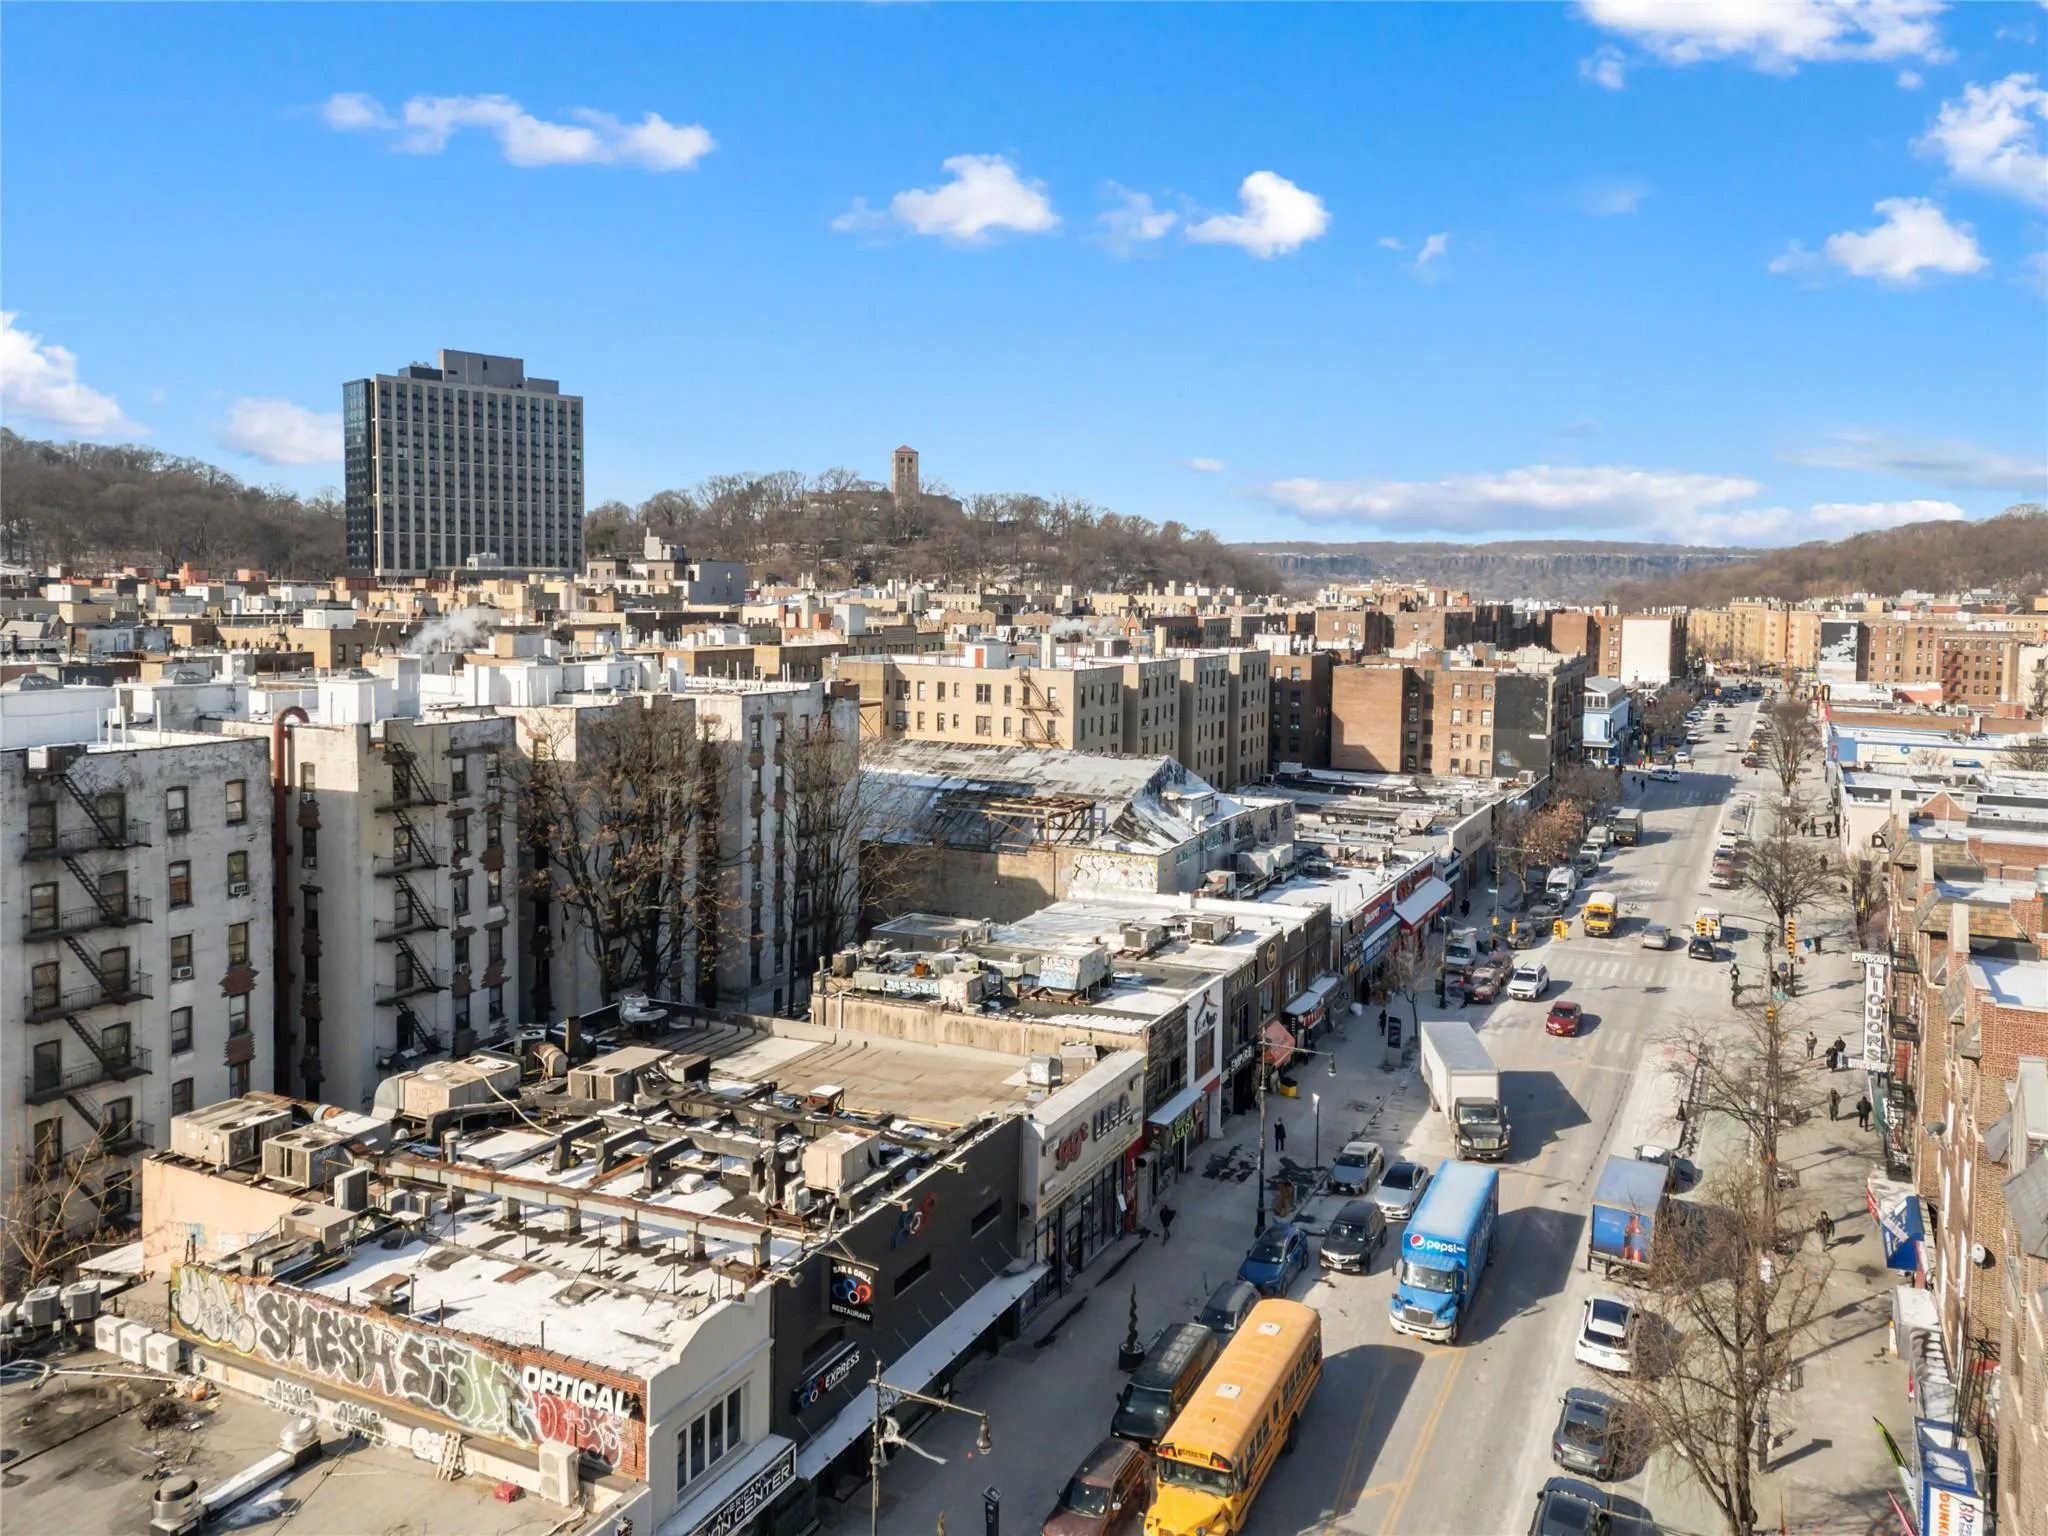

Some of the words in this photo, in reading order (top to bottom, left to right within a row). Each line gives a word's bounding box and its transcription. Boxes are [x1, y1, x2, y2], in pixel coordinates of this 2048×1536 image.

[1867, 966, 1882, 1062] LIQUORS
[1426, 1239, 1457, 1253] pepsi
[833, 1264, 847, 1274] BAR
[853, 1267, 872, 1285] GRILL
[831, 1303, 871, 1322] RESTAURANT
[825, 1351, 861, 1388] EXPRESS
[522, 1365, 632, 1419] OPTICAL
[708, 1514, 731, 1536] ON
[734, 1464, 791, 1523] CENTER
[716, 1479, 763, 1523] AMERICAN
[1938, 1492, 1951, 1536] DUNKI
